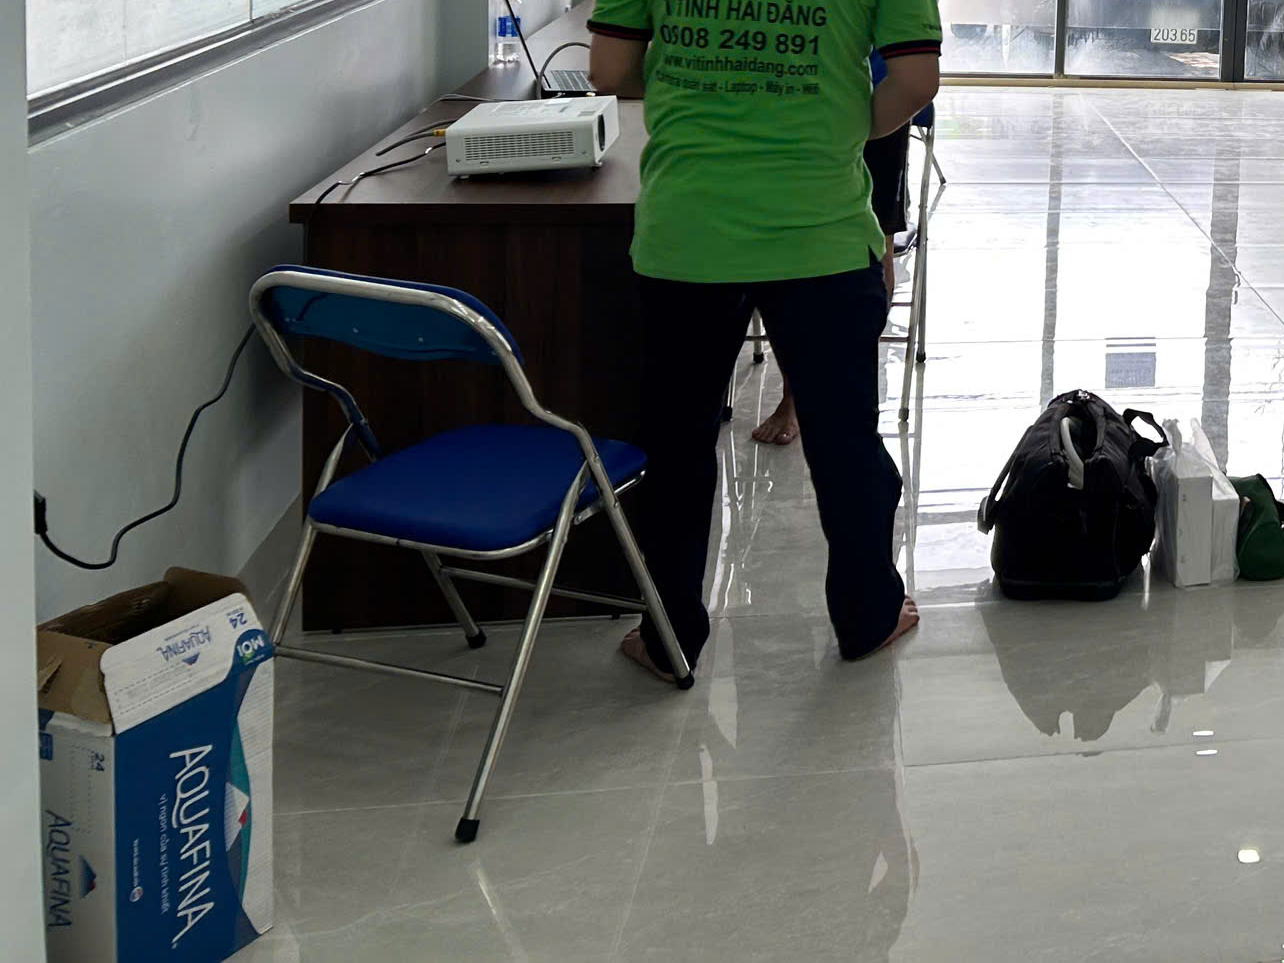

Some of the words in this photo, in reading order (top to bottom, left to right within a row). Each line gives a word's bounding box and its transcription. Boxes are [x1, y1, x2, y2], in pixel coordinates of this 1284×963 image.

[718, 29, 767, 51] 249
[775, 33, 819, 55] 891
[228, 613, 247, 629] 24
[157, 625, 212, 662] AQUAFINA
[169, 744, 215, 946] AQUAFINA
[45, 809, 73, 928] AQUAFINA
